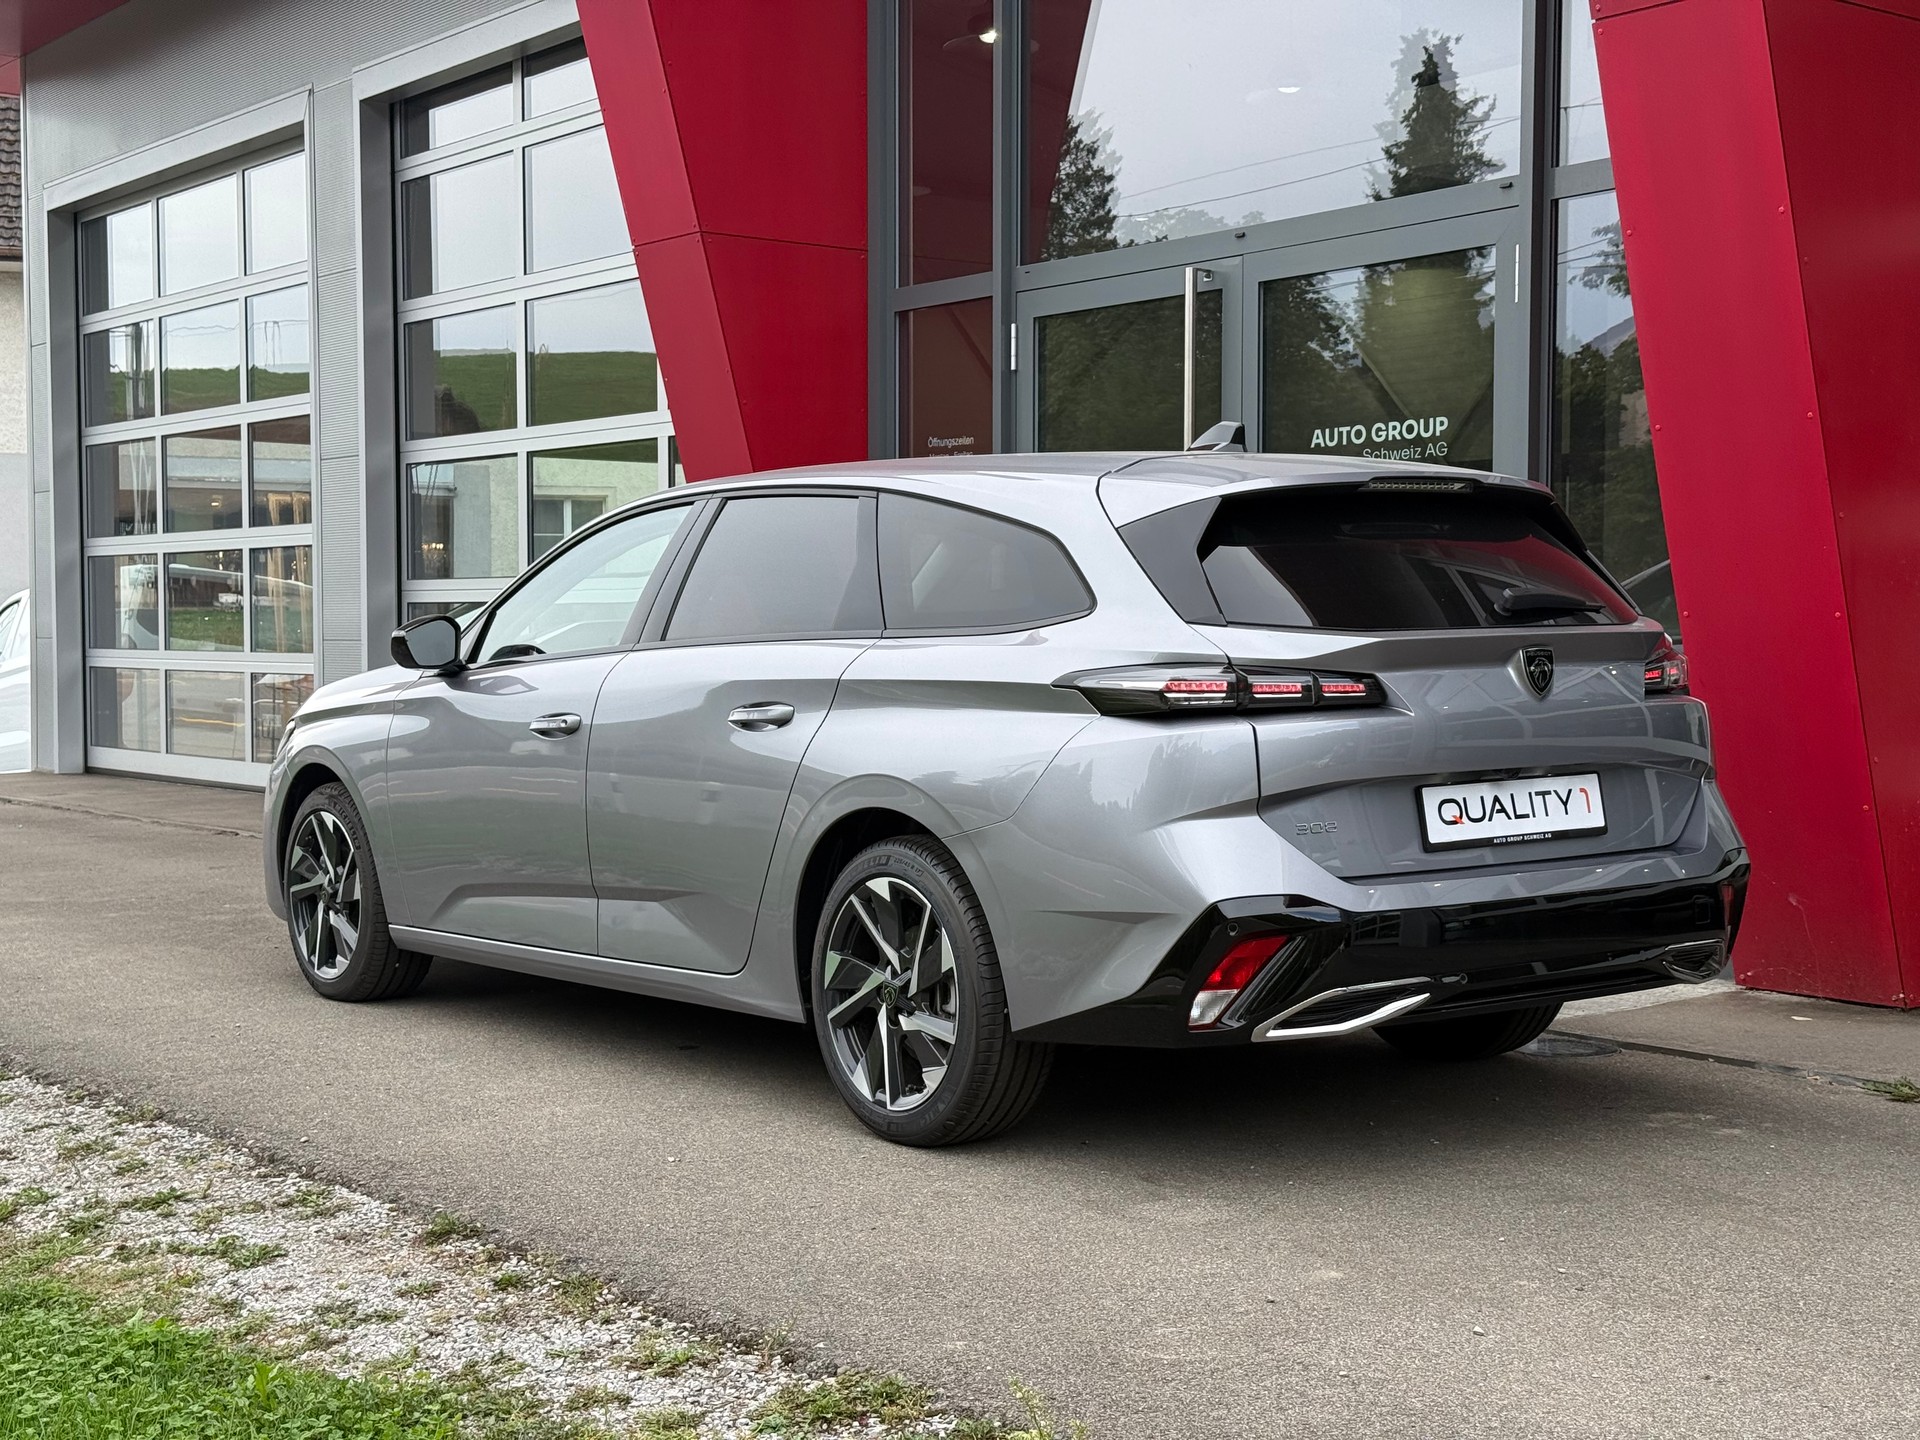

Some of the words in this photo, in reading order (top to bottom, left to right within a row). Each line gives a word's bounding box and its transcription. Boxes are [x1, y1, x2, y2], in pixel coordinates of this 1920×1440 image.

[1310, 425, 1366, 448] AUTO
[1371, 416, 1449, 442] GROUP
[927, 436, 974, 448] Öffnungszeiten
[1363, 444, 1421, 460] Schweiz
[1425, 441, 1448, 457] AG
[1296, 821, 1337, 835] 308
